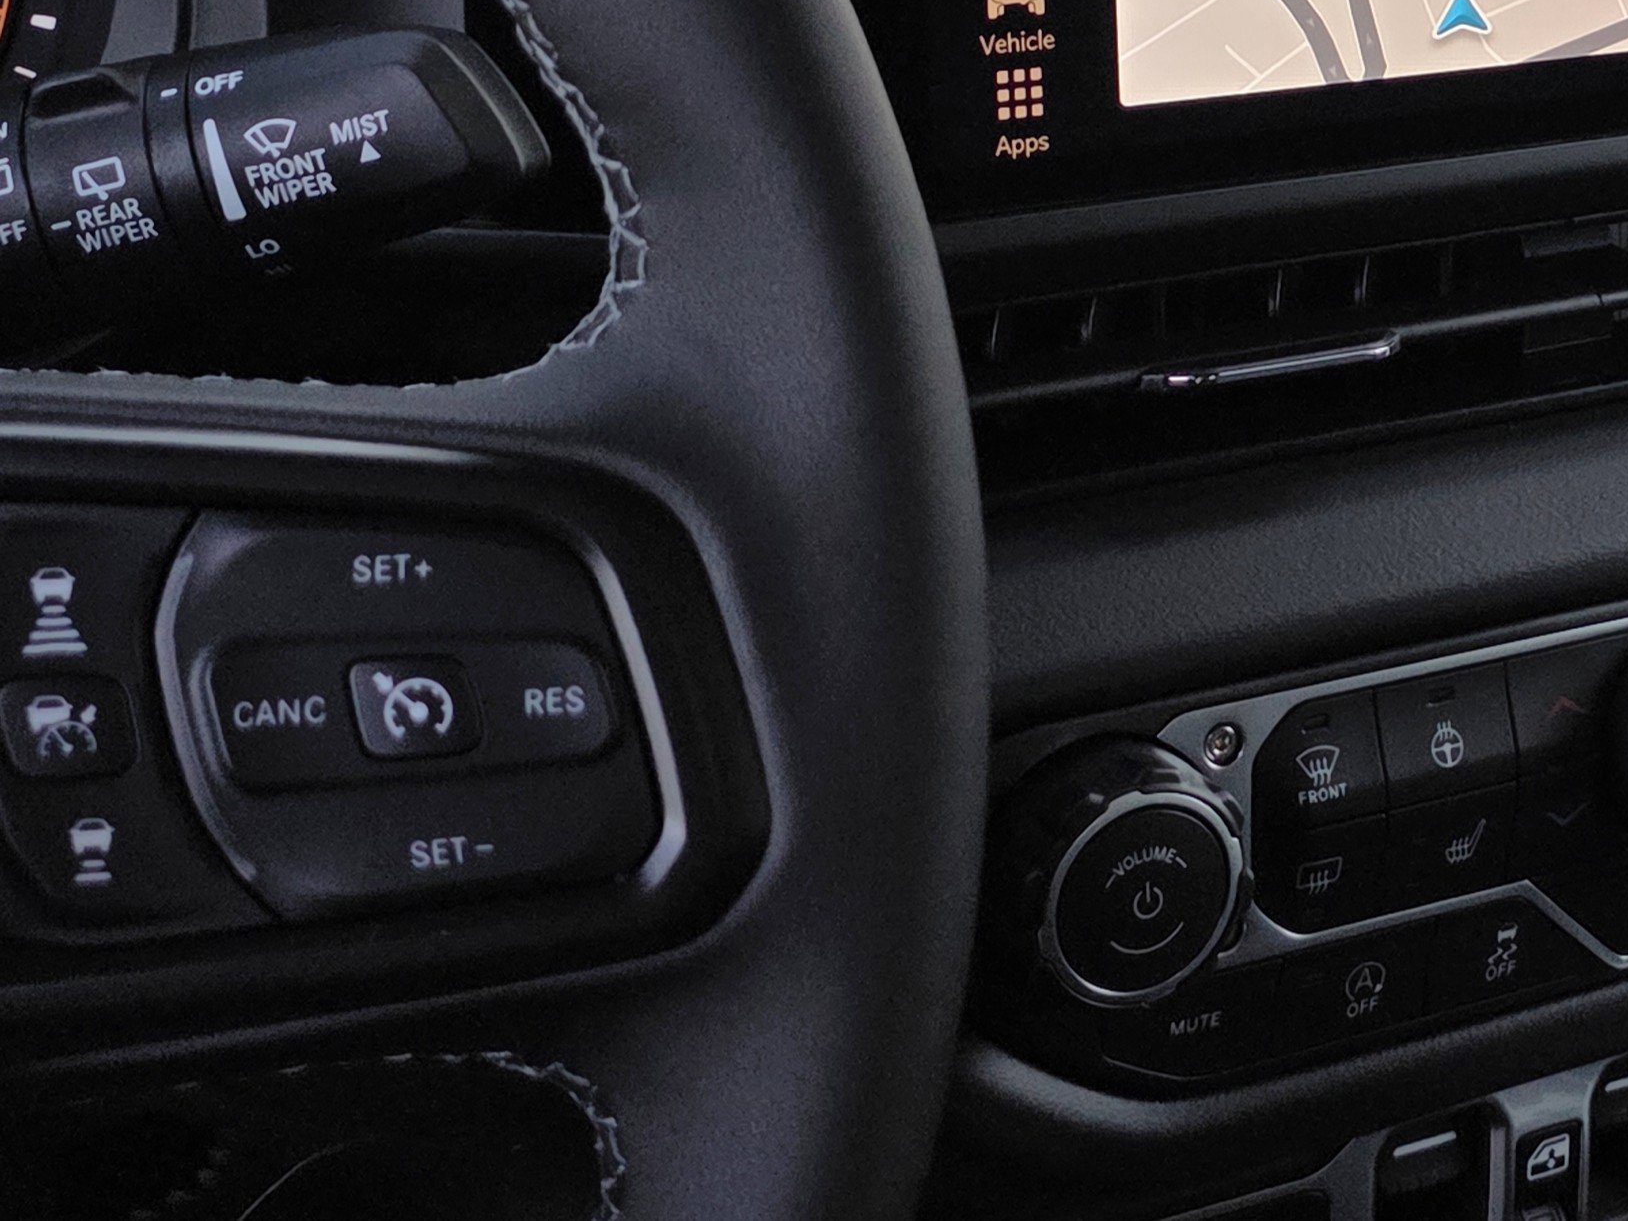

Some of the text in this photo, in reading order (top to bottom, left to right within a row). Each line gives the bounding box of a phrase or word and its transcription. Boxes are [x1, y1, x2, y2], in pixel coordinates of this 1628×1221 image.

[979, 29, 1056, 56] Vehicle
[195, 69, 245, 96] OFF
[328, 109, 390, 146] MIST
[995, 134, 1050, 160] Apps
[244, 147, 327, 188] FRONT
[253, 171, 338, 210] WIPER
[75, 197, 143, 231] REAR
[75, 217, 159, 254] WIPER
[244, 238, 281, 259] LO
[233, 694, 327, 729] CANC
[524, 685, 586, 717] RES
[1298, 782, 1347, 806] FRONT
[1112, 845, 1177, 877] VOLUME
[1485, 960, 1517, 981] OFF
[1347, 996, 1380, 1018] OFF
[1170, 1011, 1223, 1036] MUTE
